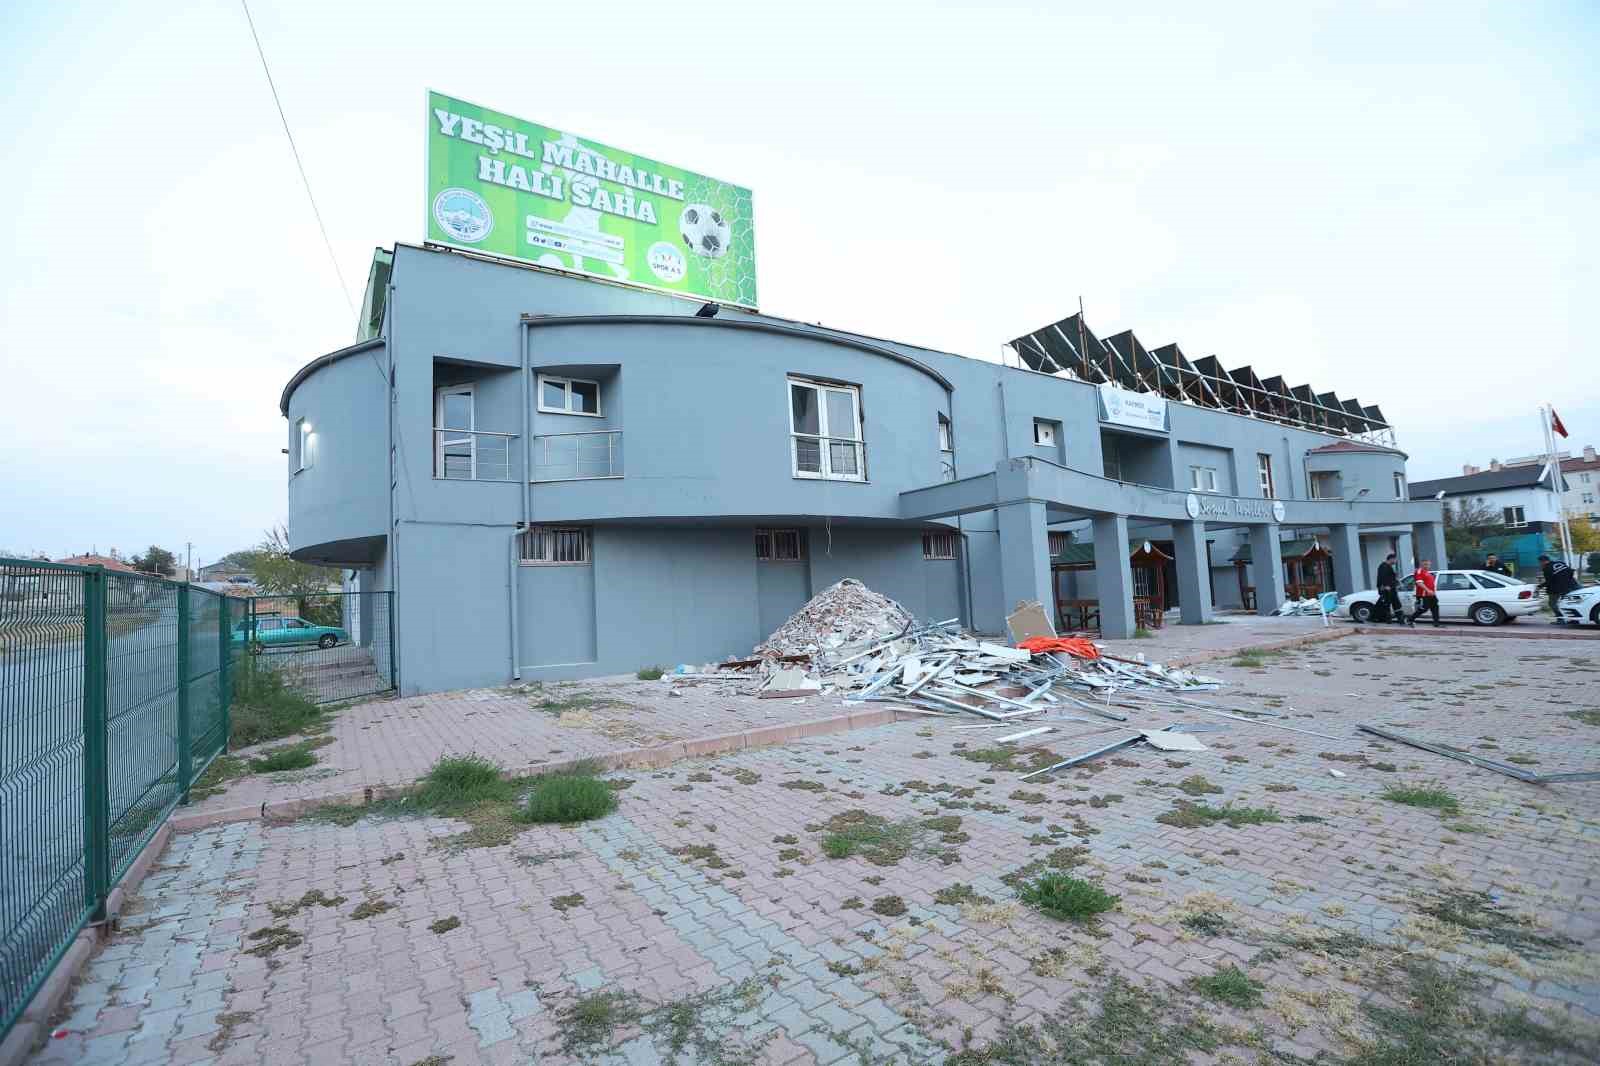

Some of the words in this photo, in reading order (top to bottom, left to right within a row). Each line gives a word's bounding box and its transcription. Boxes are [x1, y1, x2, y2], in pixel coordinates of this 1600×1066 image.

[477, 155, 565, 202] HALI
[570, 179, 658, 225] SAHA
[541, 140, 684, 202] MAHALLE
